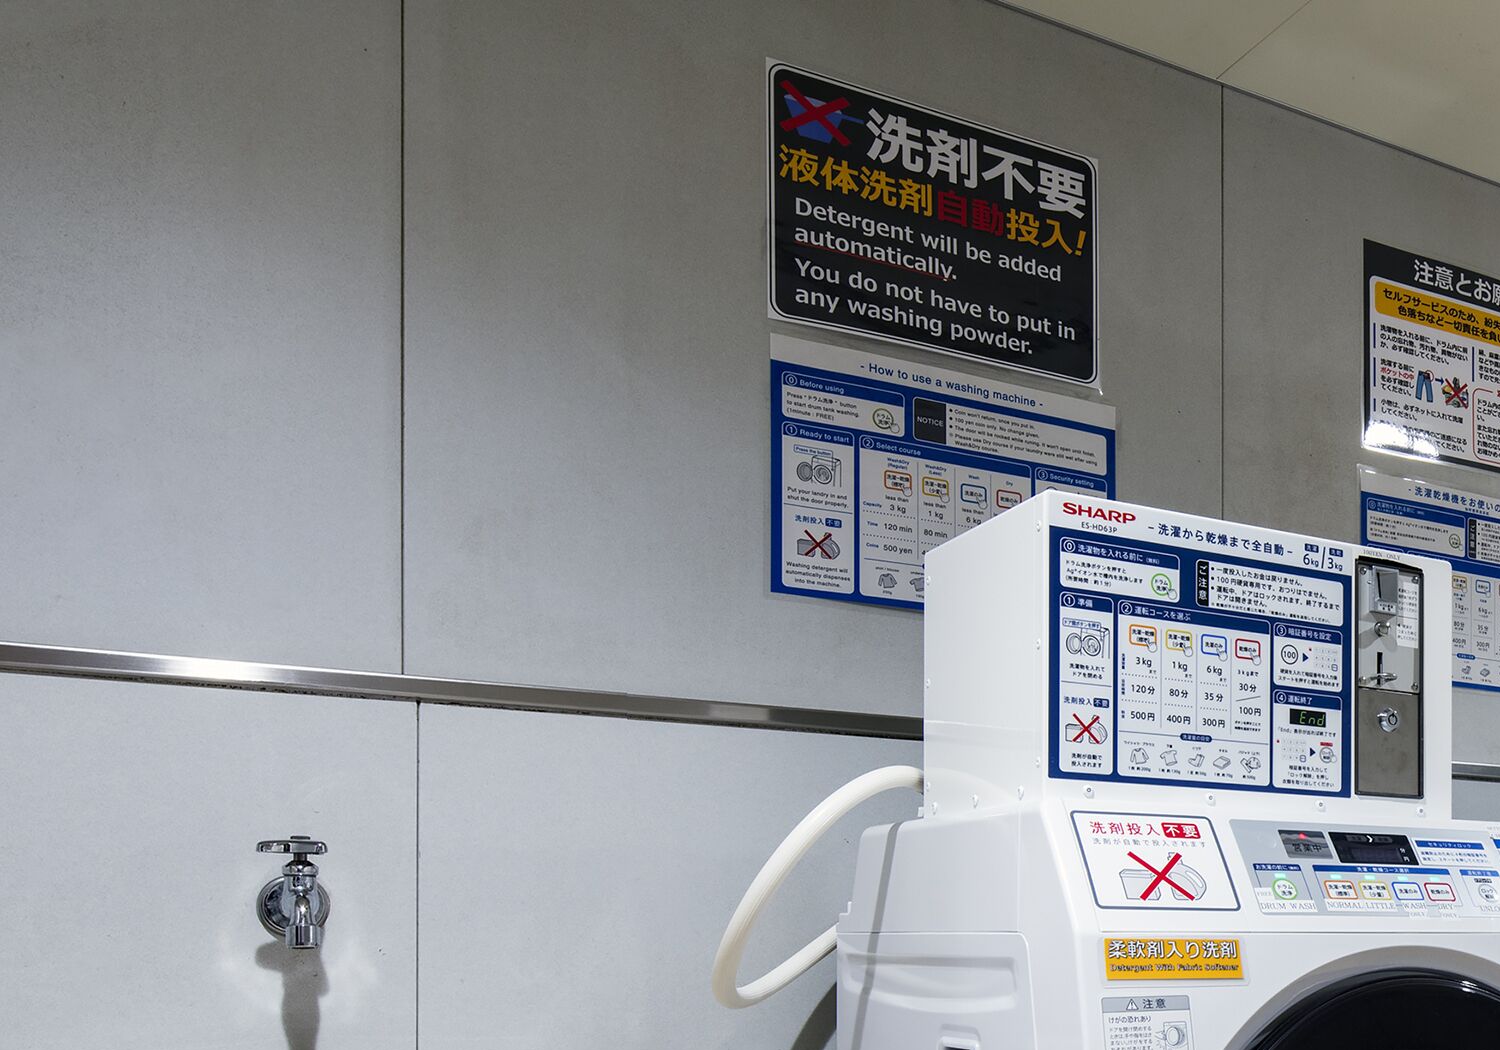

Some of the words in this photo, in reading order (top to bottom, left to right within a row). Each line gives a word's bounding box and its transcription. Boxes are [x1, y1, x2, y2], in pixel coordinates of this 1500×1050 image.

[865, 107, 1087, 219] 洗剤不要
[795, 197, 913, 243] Detergent
[921, 230, 958, 255] will
[966, 241, 991, 264] be
[999, 250, 1061, 282] added
[795, 226, 957, 281] automatically.
[795, 258, 840, 285] You
[849, 271, 877, 293] do
[886, 282, 923, 304] not
[931, 288, 982, 318] have
[988, 305, 1010, 324] to
[1018, 313, 1052, 335] put
[1058, 320, 1076, 340] in
[795, 288, 839, 312] any
[848, 298, 942, 337] washing
[951, 321, 1032, 354] powder.
[800, 379, 823, 390] Before
[825, 385, 844, 394] using
[869, 363, 893, 377] How
[898, 369, 908, 380] to
[912, 375, 931, 385] use
[935, 379, 942, 387] a
[946, 382, 989, 399] washing
[993, 391, 1035, 407] machine
[917, 416, 944, 427] NOTICE
[800, 429, 822, 439] Ready
[834, 435, 850, 443] start
[876, 442, 897, 451] Select
[899, 447, 921, 456] course
[1050, 473, 1073, 485] Security
[1075, 478, 1094, 488] setting
[897, 506, 906, 514] kg
[1063, 502, 1136, 523] SHARP
[884, 523, 897, 531] 120
[1158, 522, 1285, 557] 洗濯から乾燥まで全自動
[883, 544, 897, 552] 500
[1077, 544, 1143, 562] 洗濯物を入れる前に
[1077, 595, 1093, 608] 準備
[1134, 604, 1191, 621] 運転コースを選ぶ
[1287, 628, 1332, 641] 暗証番号を設定
[1287, 695, 1312, 705] 運転終了
[1131, 711, 1155, 722] 500円
[1239, 706, 1261, 717] 100円
[1167, 715, 1191, 725] 400円
[1202, 718, 1225, 729] 300円
[1299, 711, 1325, 726] End
[1261, 902, 1289, 910] DRUM
[1327, 901, 1363, 909] NORMAL
[1366, 902, 1396, 910] LITTLE
[1108, 939, 1237, 959] 柔軟剤入り洗剤
[1110, 964, 1153, 972] Detergent
[1143, 998, 1166, 1009] 注意
